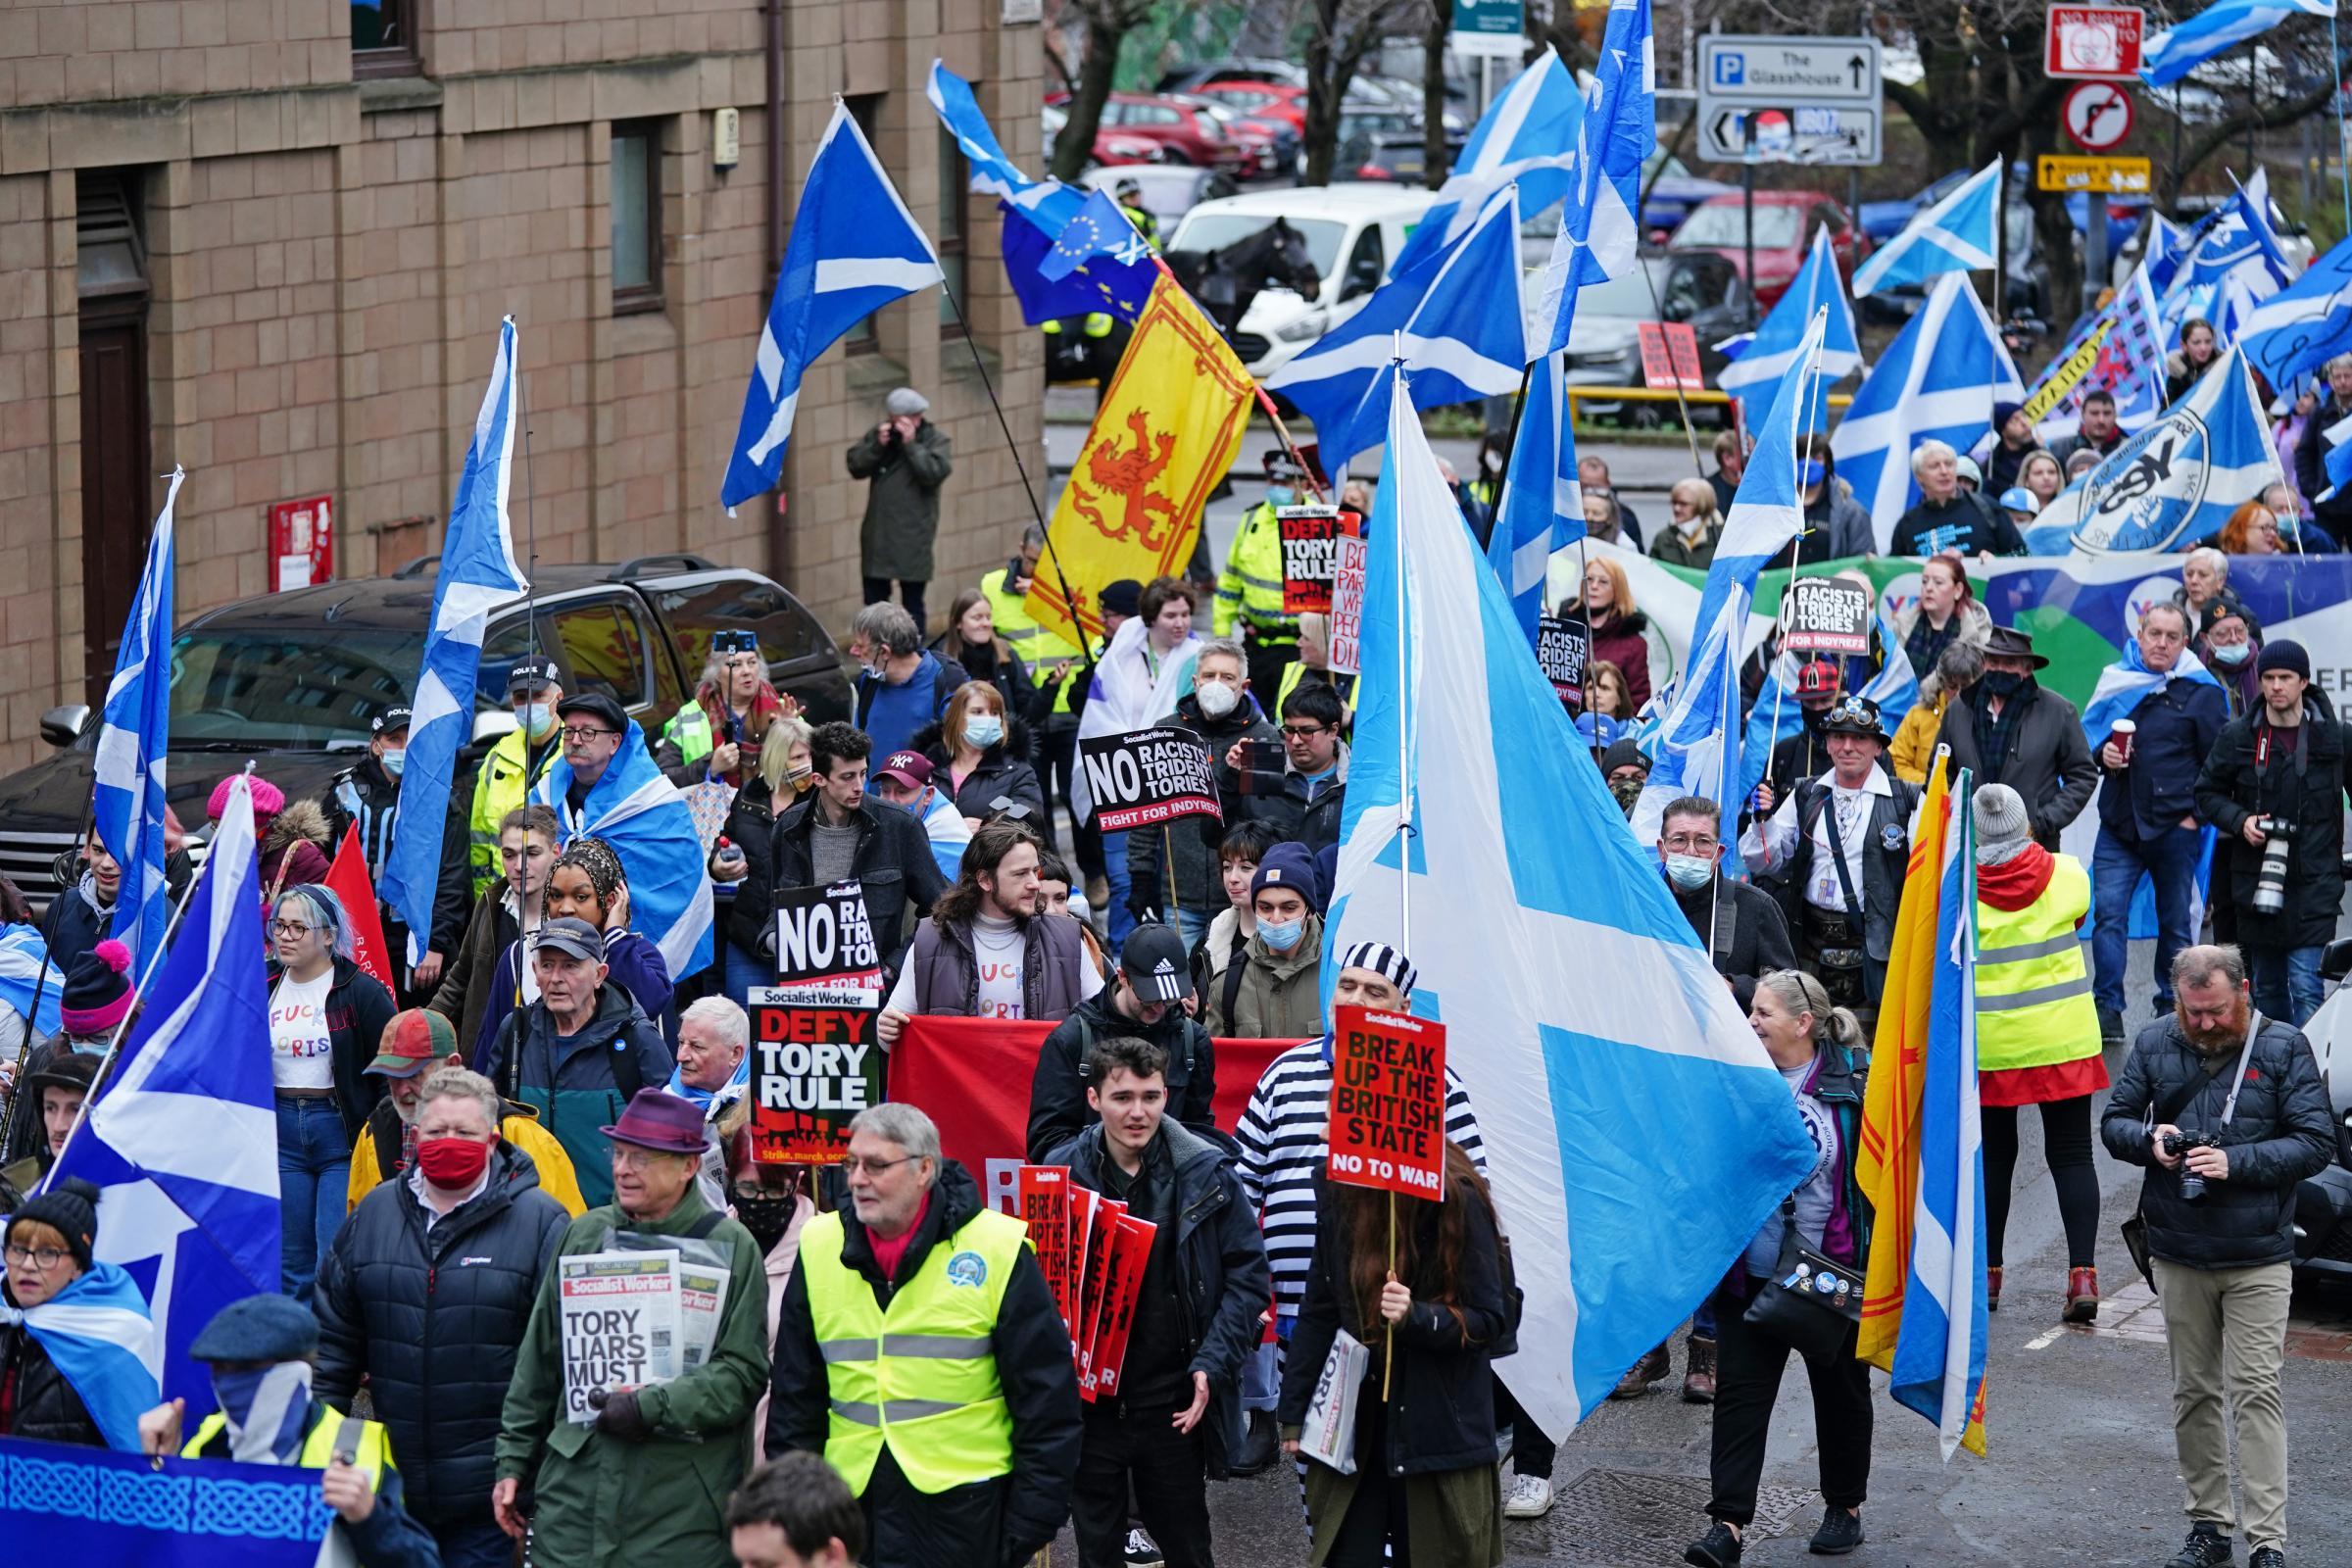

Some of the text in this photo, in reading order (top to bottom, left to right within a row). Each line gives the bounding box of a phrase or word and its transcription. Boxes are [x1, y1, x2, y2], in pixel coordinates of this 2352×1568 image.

[1782, 52, 1810, 66] The
[1749, 71, 1842, 84] Glasshouse
[1282, 518, 1334, 540] DEFY
[1283, 538, 1336, 560] TORY
[1286, 559, 1336, 580] RULE
[1797, 586, 1865, 606] RACISTS
[1797, 601, 1865, 620] TRIDENT
[1797, 614, 1854, 633] TORIES
[1538, 630, 1585, 655] ACISTS
[1789, 635, 1866, 648] FOR INDYREF2
[1539, 647, 1585, 669] RIDENT
[1540, 662, 1578, 684] ORIES
[387, 708, 413, 718] POLIC
[1123, 731, 1175, 745] Socialist Worker
[1138, 741, 1207, 764] RACISTS
[1084, 749, 1141, 807] NO
[1142, 759, 1211, 782] TRIDENT
[1146, 775, 1209, 799] TORIES
[1100, 800, 1221, 828] FIGHT FOR INDYREF2
[778, 903, 836, 973] NO
[764, 991, 863, 1005] Socialist Worker
[270, 1005, 325, 1028] FUCK
[760, 1009, 869, 1044] DEFY
[1364, 1012, 1423, 1033] Socialist Worker
[277, 1037, 329, 1058] ORIS
[1348, 1032, 1435, 1074] BREAK
[758, 1042, 869, 1077] TORY
[760, 1074, 868, 1109] RULE
[1345, 1058, 1437, 1104] UP THE
[1337, 1087, 1440, 1133] BRITISH
[1348, 1117, 1427, 1158] STATE
[1332, 1153, 1439, 1190] NO TO WAR
[1027, 1194, 1064, 1220] BREAK
[571, 1275, 672, 1295] Socialist Worker
[682, 1295, 715, 1310] orker
[565, 1308, 640, 1336] TORY
[567, 1334, 647, 1361] LIARS
[568, 1359, 647, 1387] MUST
